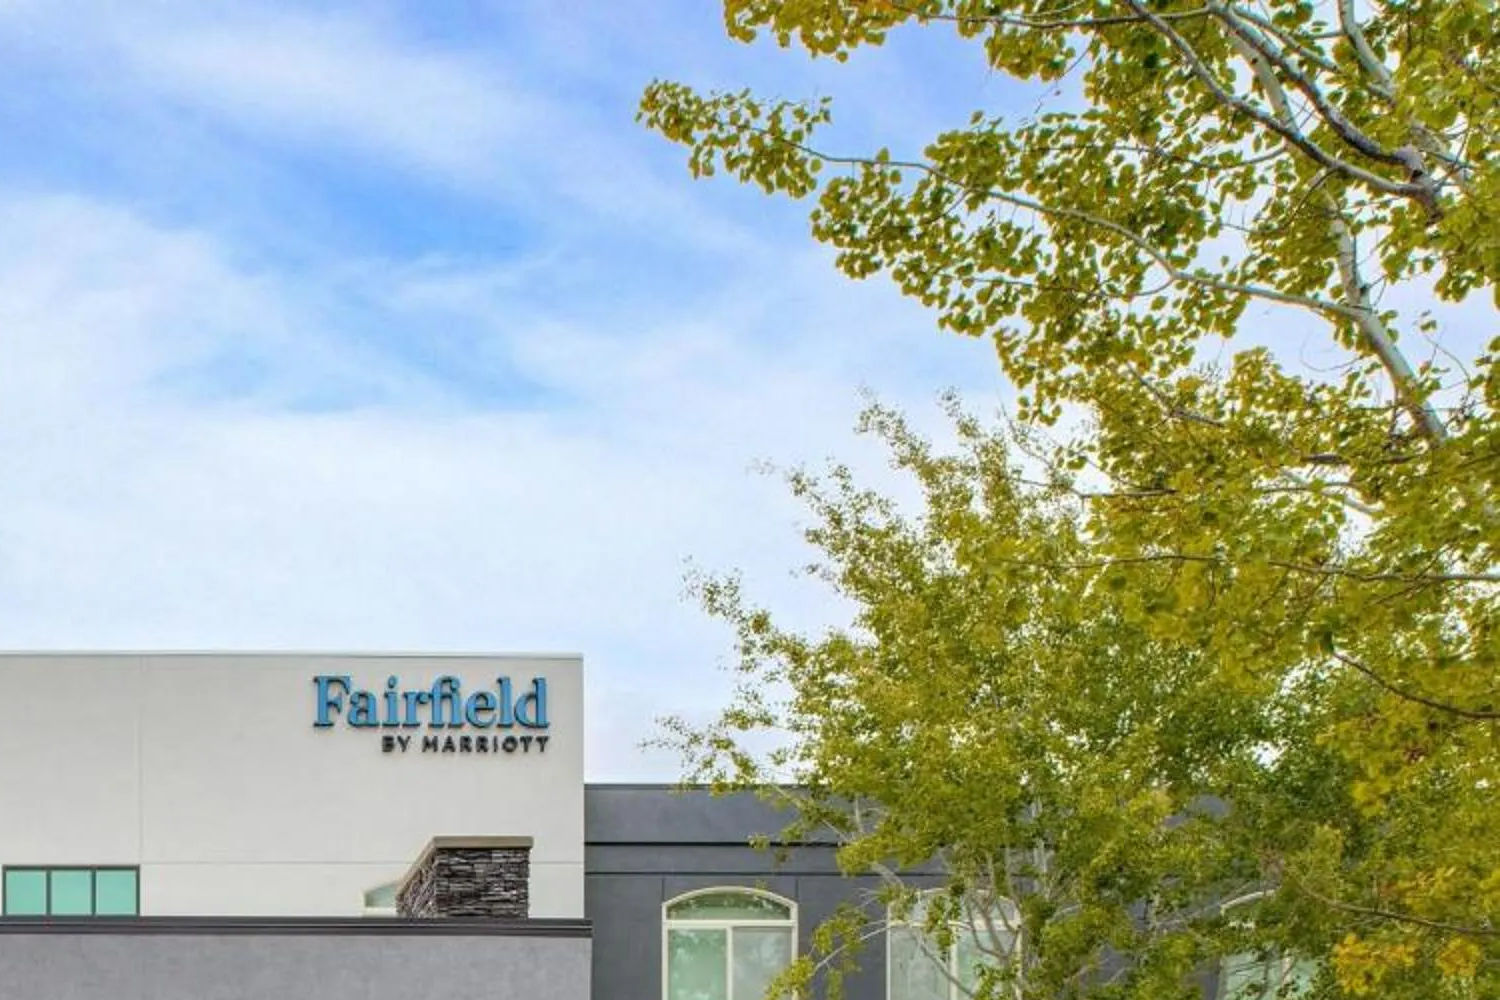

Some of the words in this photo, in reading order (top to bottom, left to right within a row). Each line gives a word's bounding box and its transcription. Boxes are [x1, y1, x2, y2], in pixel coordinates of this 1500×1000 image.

[313, 675, 550, 729] Fairfield
[382, 735, 411, 752] BY
[421, 736, 550, 753] MARRIOTT
